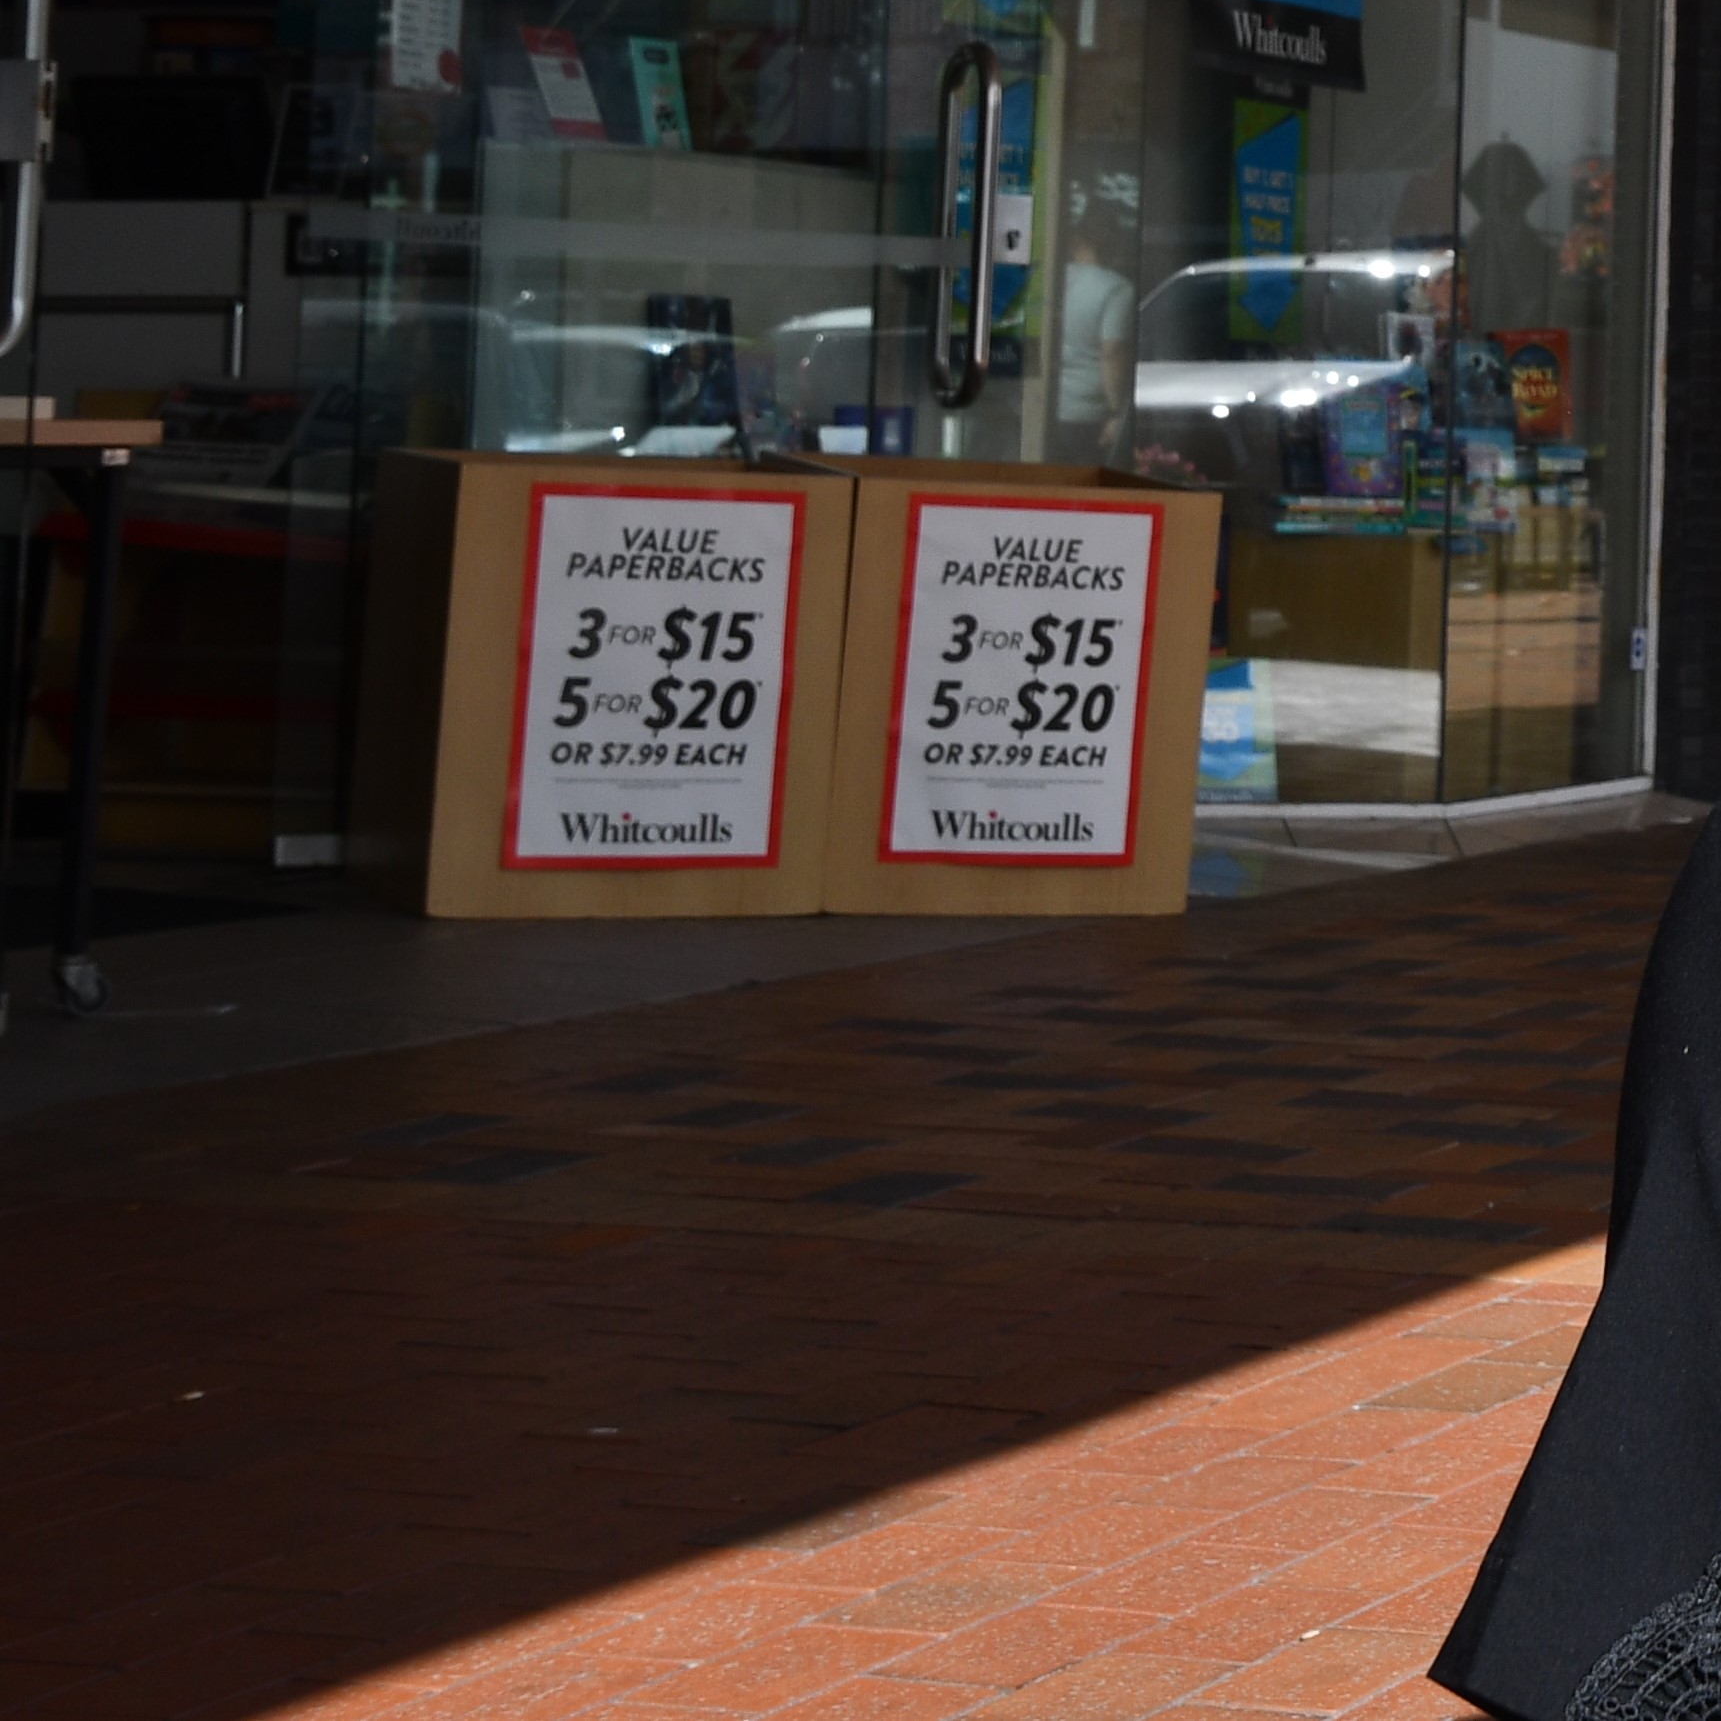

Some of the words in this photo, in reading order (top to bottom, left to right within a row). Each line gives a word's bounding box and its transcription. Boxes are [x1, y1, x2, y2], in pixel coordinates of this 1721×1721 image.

[1231, 9, 1328, 66] Whitcoulls
[622, 526, 719, 555] VALUE
[993, 536, 1083, 564] VALUE
[566, 552, 766, 584] PAPERBACKS
[941, 561, 1125, 592] PAPERBACKS
[568, 608, 608, 659] 3
[608, 624, 656, 646] FOR
[941, 614, 978, 664] 3
[978, 629, 1024, 651] FOR
[553, 677, 592, 728] 5
[593, 693, 642, 715] FOR
[926, 680, 963, 731] 5
[963, 695, 1010, 717] FOR
[550, 741, 593, 766] OR
[599, 743, 669, 767] $7.99
[675, 743, 747, 767] EACH
[923, 742, 964, 766] OR
[968, 744, 1033, 767] $7.99
[1039, 745, 1107, 768] EACH
[560, 812, 733, 844] Whitcoulls
[931, 809, 1095, 842] Whitcoulls
